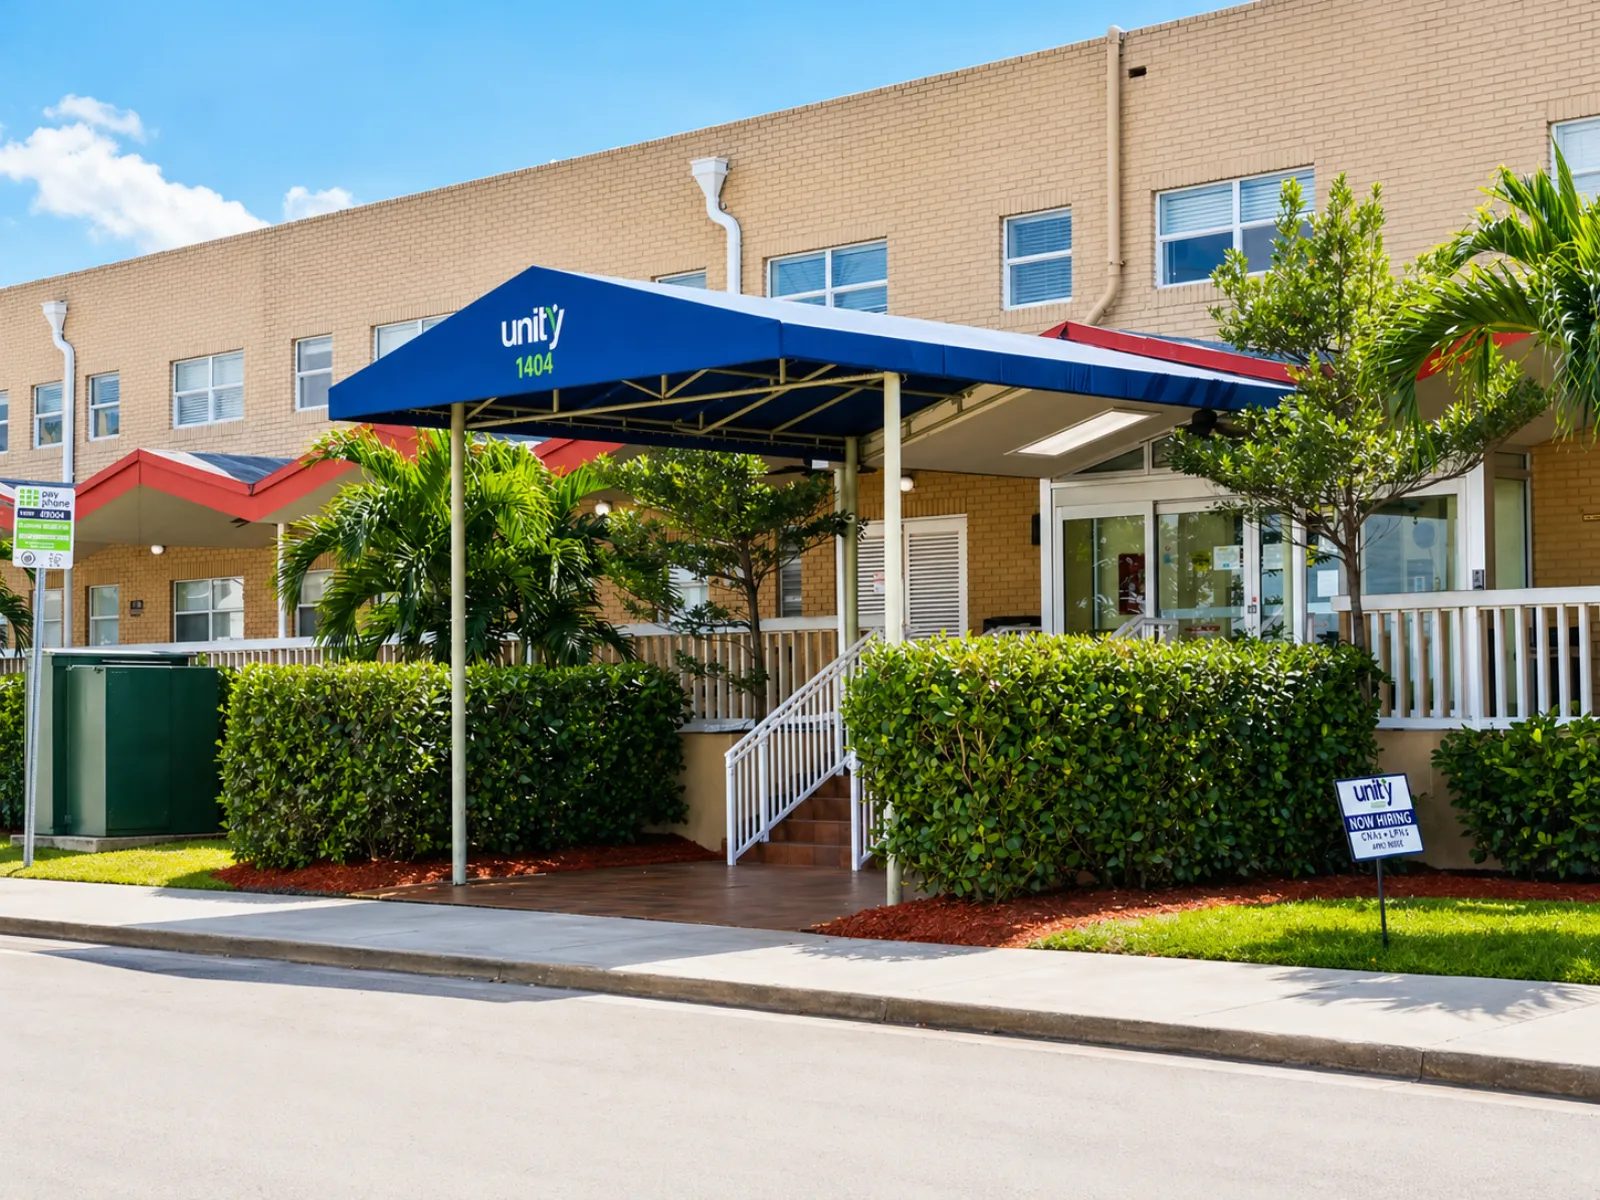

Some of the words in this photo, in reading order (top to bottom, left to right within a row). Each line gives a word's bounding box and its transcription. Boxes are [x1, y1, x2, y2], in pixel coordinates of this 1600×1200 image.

[501, 304, 565, 350] unity
[516, 351, 553, 379] 1404
[42, 490, 59, 498] pay
[1353, 778, 1392, 806] unity
[1349, 815, 1374, 830] NOW
[1376, 811, 1412, 827] HIRING
